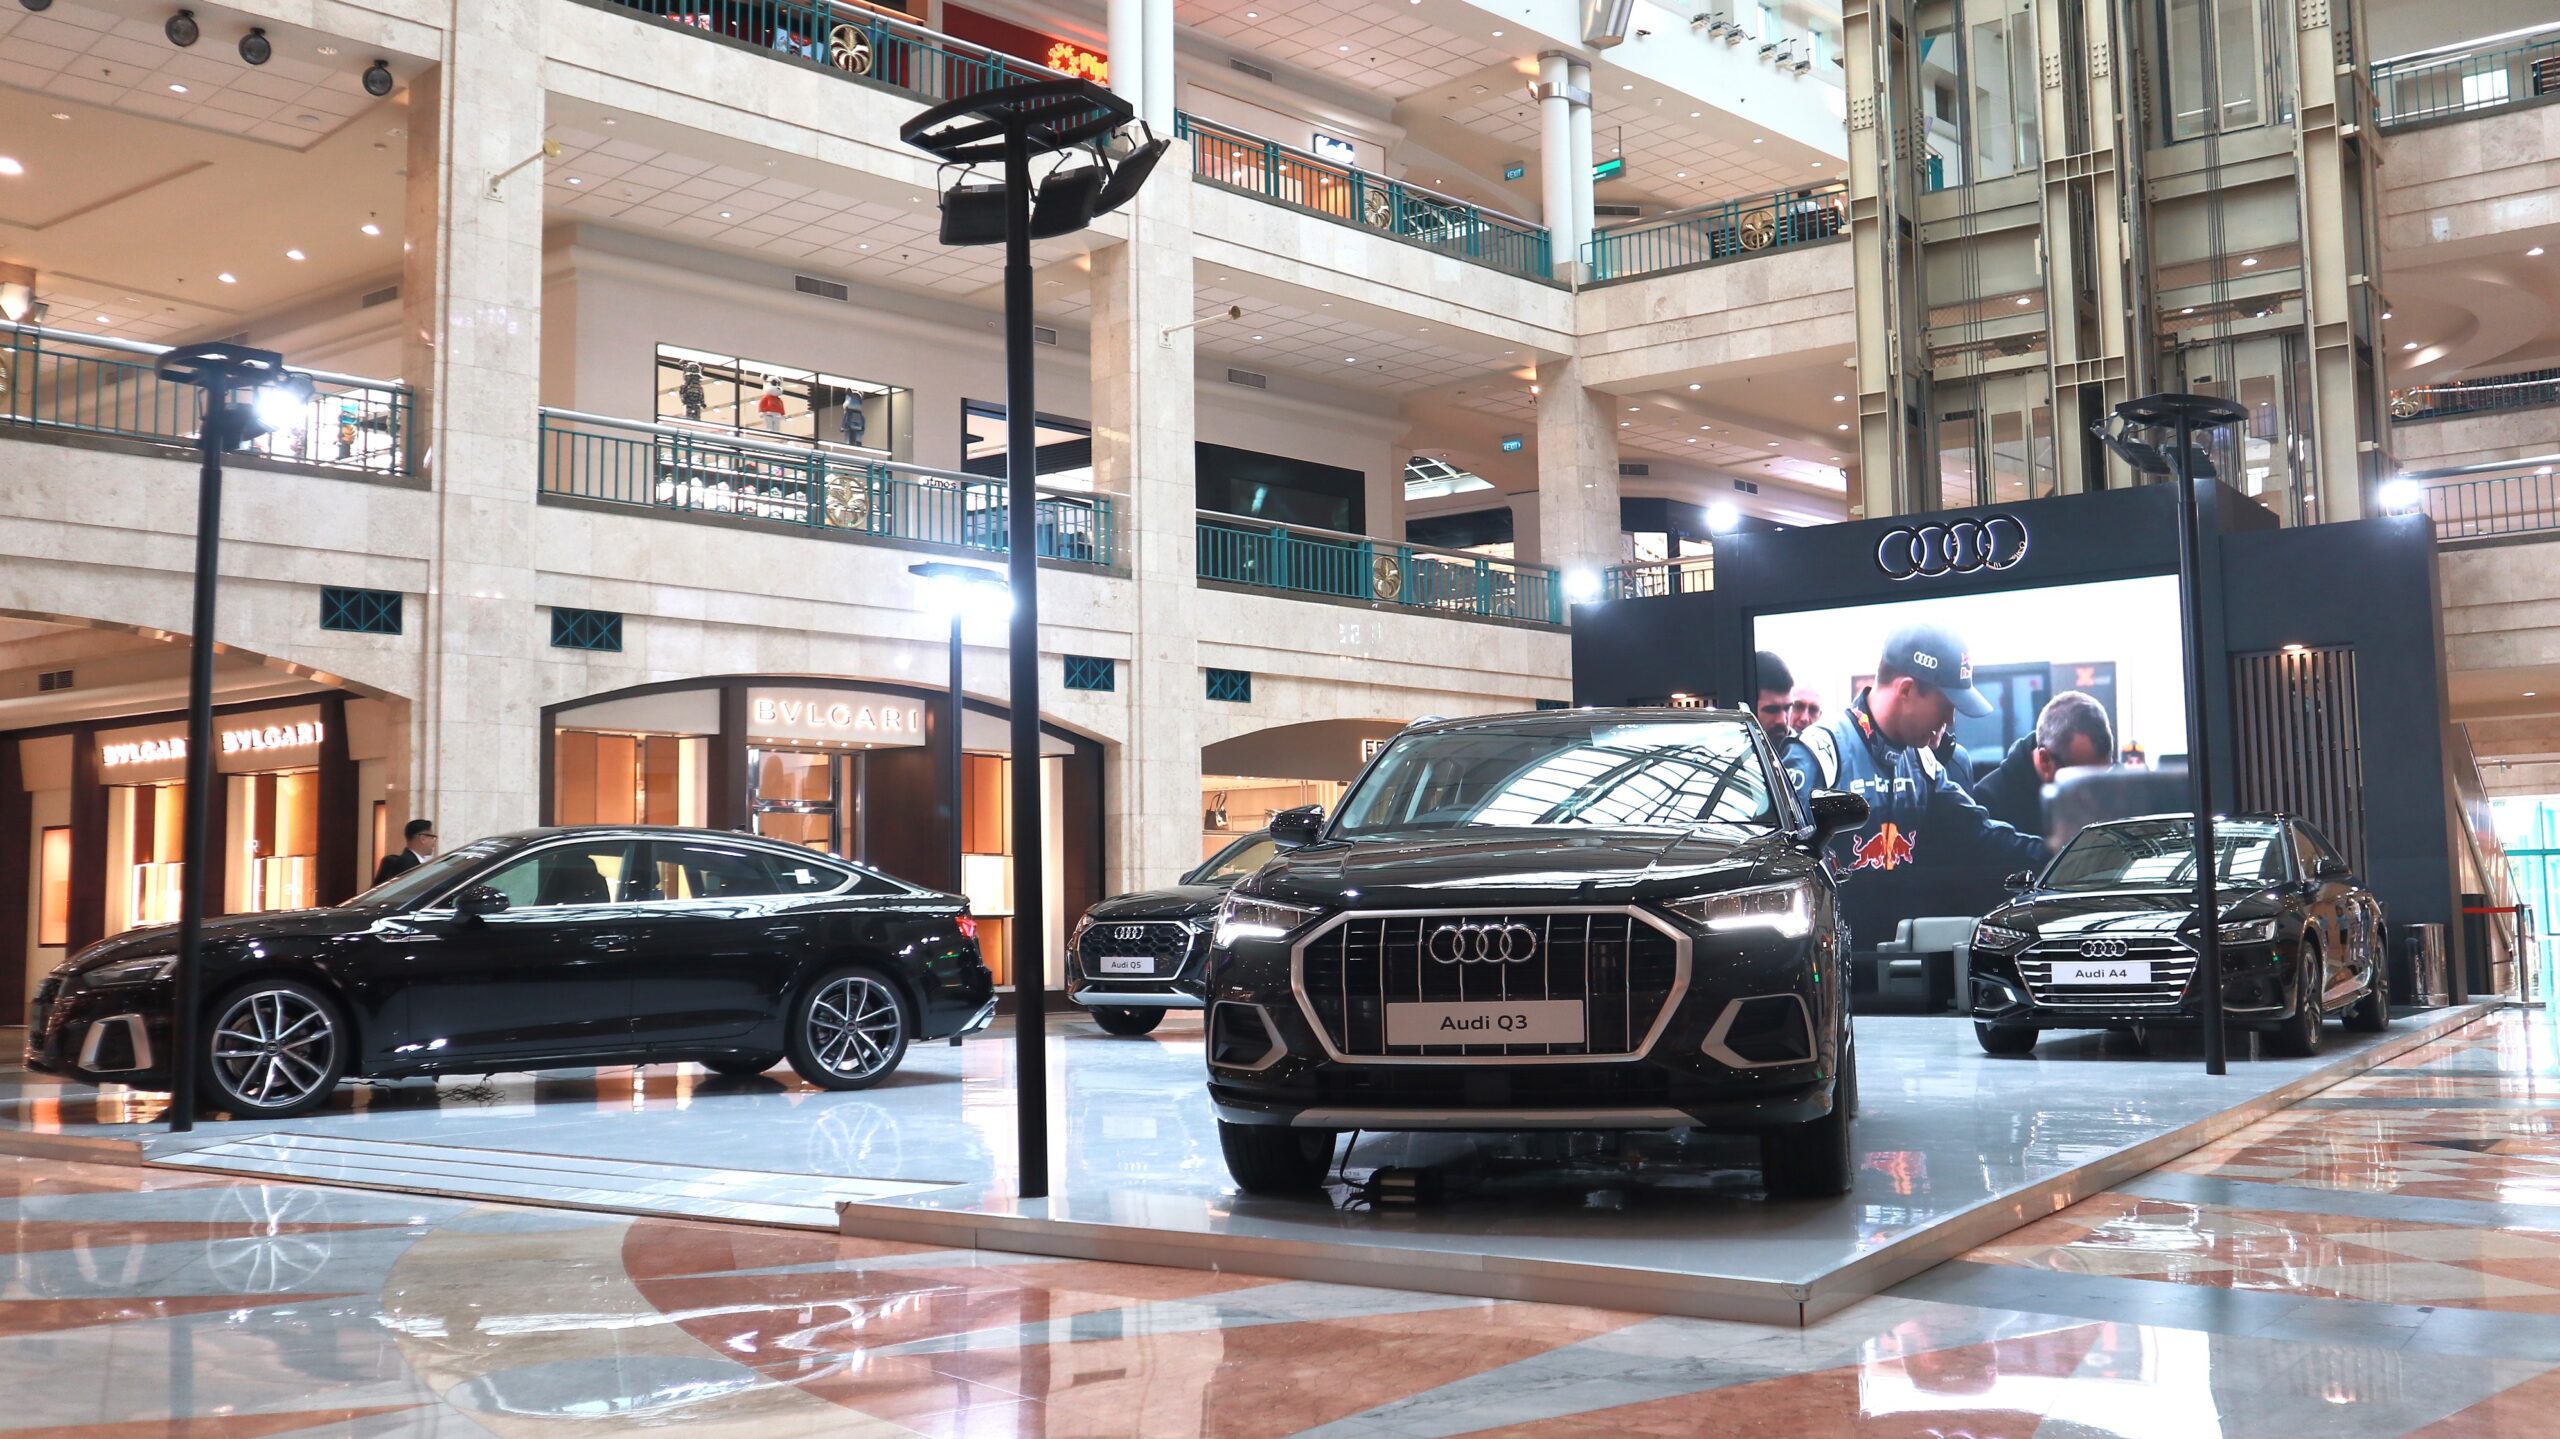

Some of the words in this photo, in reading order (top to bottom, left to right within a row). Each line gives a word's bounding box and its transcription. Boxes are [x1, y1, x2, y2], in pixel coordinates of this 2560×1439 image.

[1509, 167, 1522, 179] EXIT
[757, 700, 919, 730] BVLGARI
[222, 722, 324, 753] BVLGARI
[102, 738, 189, 767] BVLGAR
[1111, 961, 1129, 969] Audi
[1130, 961, 1142, 970] Q5
[2075, 969, 2105, 978] Audi
[2109, 969, 2128, 978] A4
[1440, 1015, 1490, 1031] Audi
[1497, 1014, 1528, 1032] Q3
